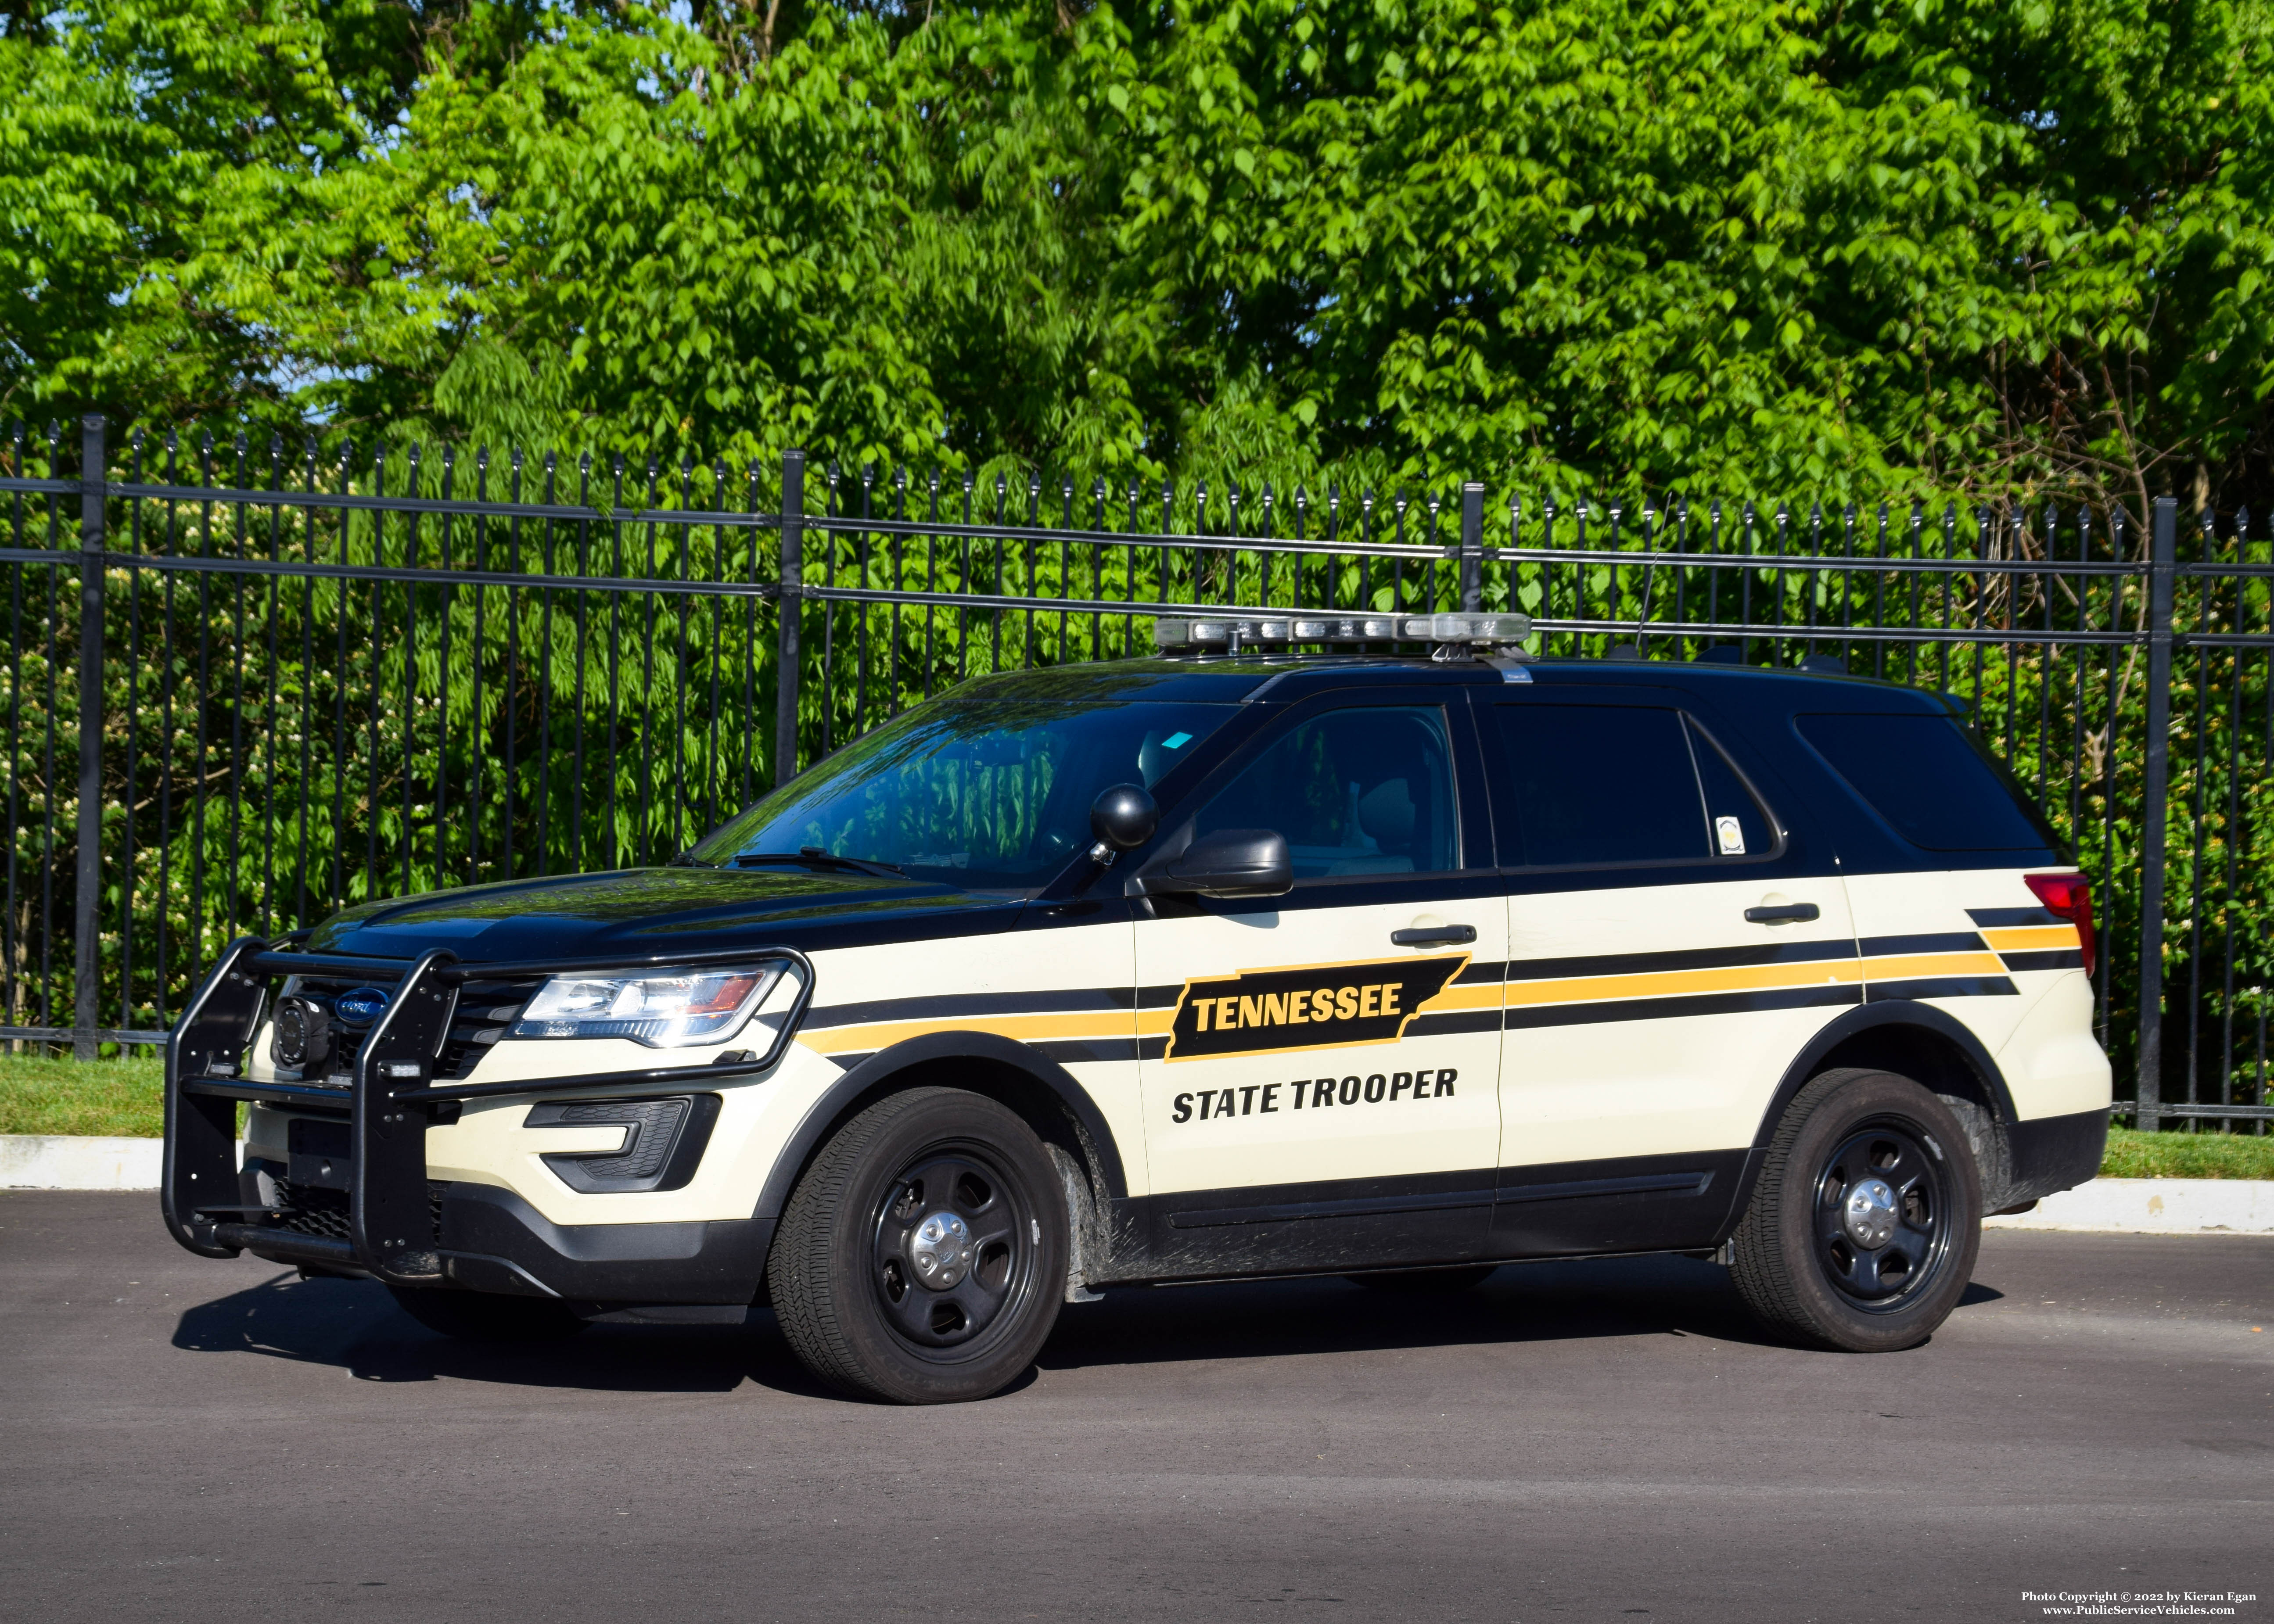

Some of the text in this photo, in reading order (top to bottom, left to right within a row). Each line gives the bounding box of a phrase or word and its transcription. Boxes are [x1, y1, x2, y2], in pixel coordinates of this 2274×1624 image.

[1192, 982, 1403, 1032] TENNESSEE
[1172, 1068, 1458, 1124] STATE TROOPER
